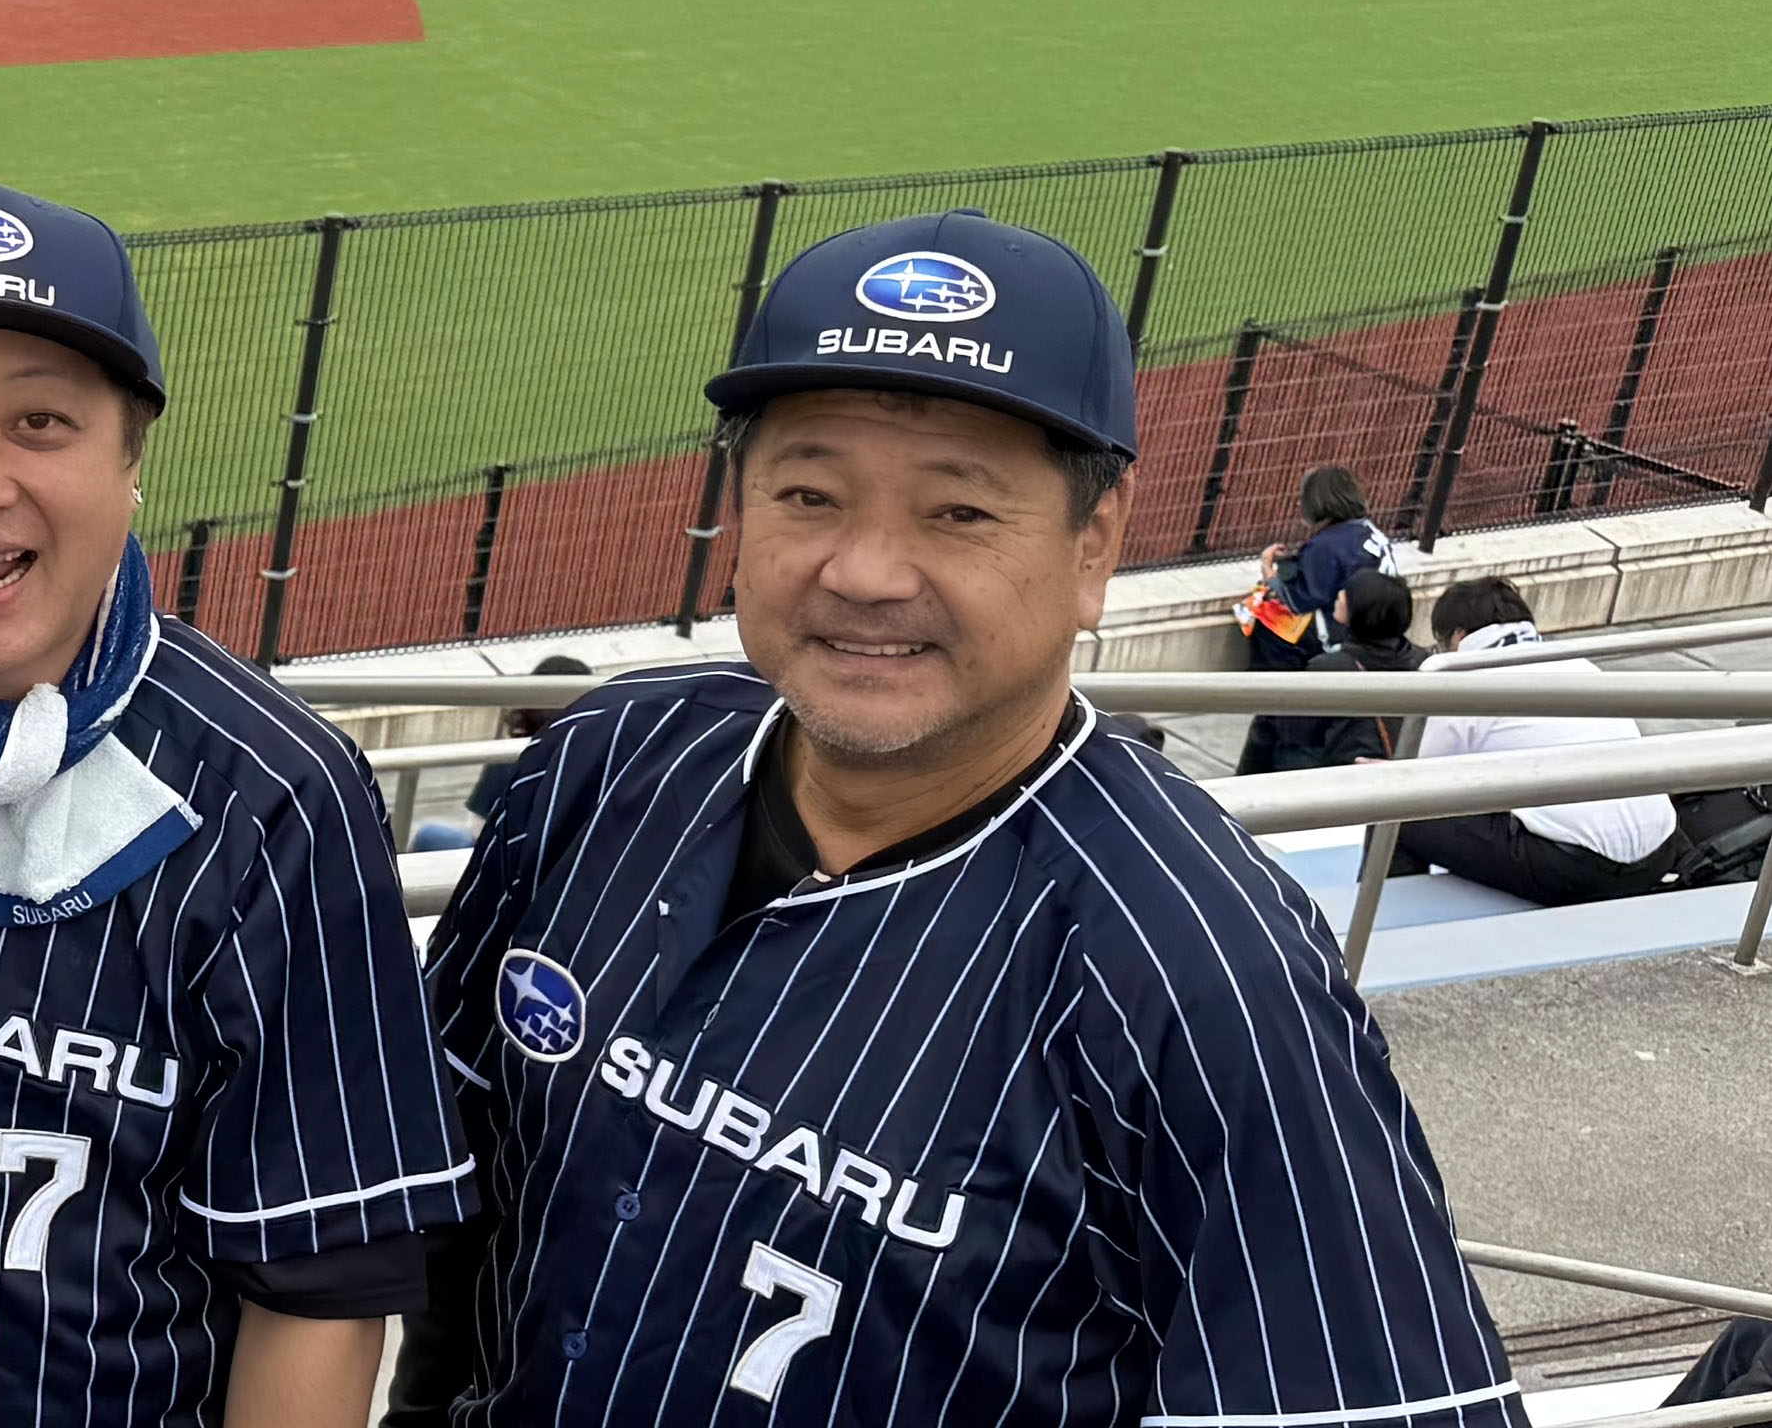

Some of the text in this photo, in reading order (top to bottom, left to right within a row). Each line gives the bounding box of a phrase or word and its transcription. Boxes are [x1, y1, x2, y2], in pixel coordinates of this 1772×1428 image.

[816, 327, 1014, 375] SUBARU
[12, 891, 95, 927] SUBARU
[600, 1035, 967, 1249] SUBARU
[730, 1239, 843, 1404] 7
